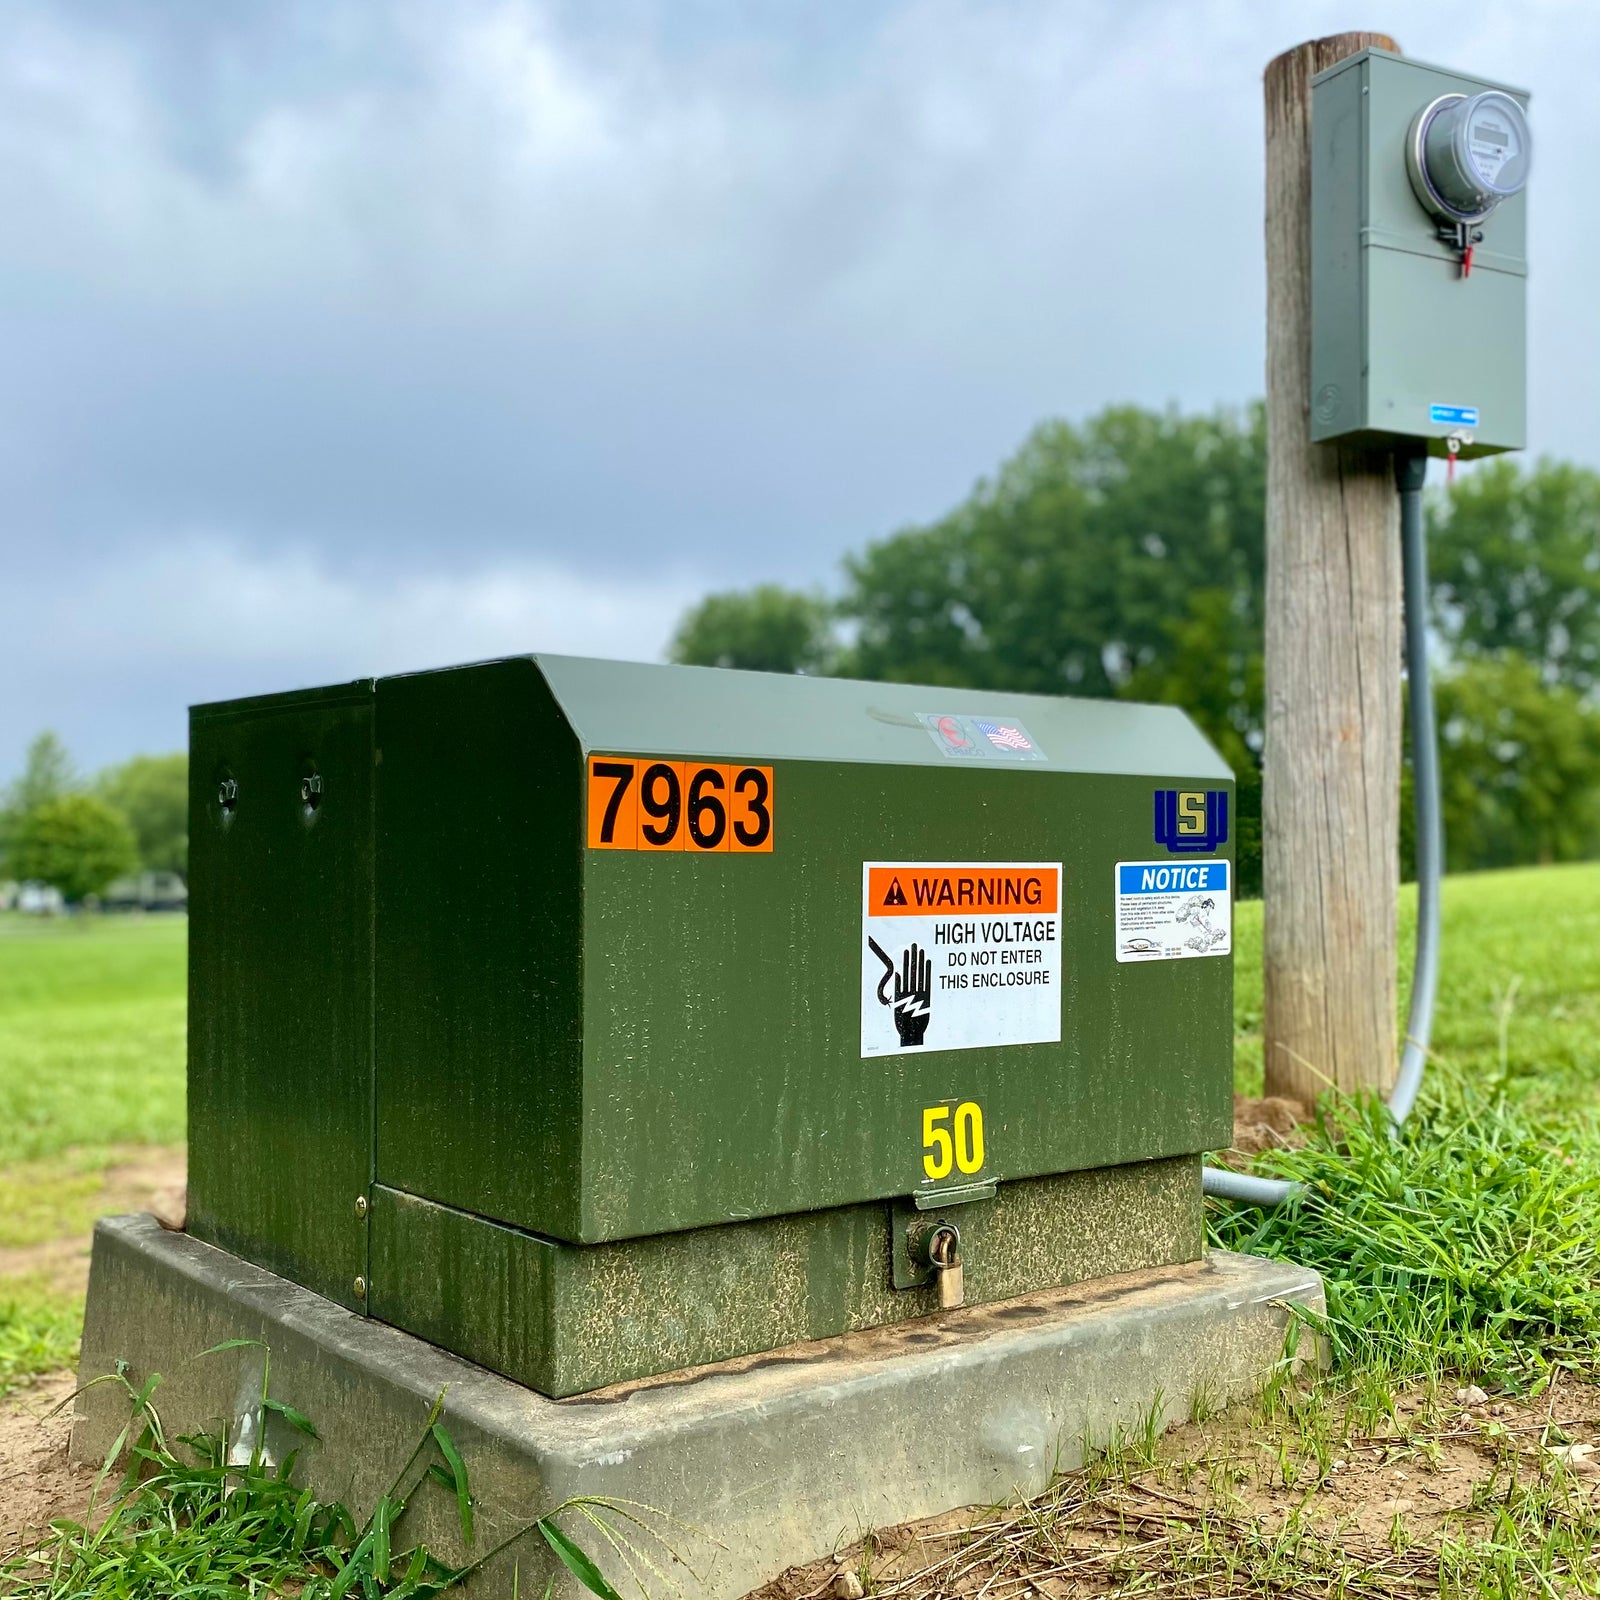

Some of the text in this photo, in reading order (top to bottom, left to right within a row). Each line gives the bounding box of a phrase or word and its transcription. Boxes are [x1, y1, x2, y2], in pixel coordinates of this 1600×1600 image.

[593, 762, 771, 849] 7963
[1141, 867, 1209, 890] NOTICE
[912, 877, 1042, 906] WARNING
[935, 921, 1056, 945] HIGH VOLTAGE
[948, 949, 1042, 967] DO NOT ENTER
[939, 970, 1050, 990] THIS ENCLOSURE
[923, 1101, 985, 1180] 50
